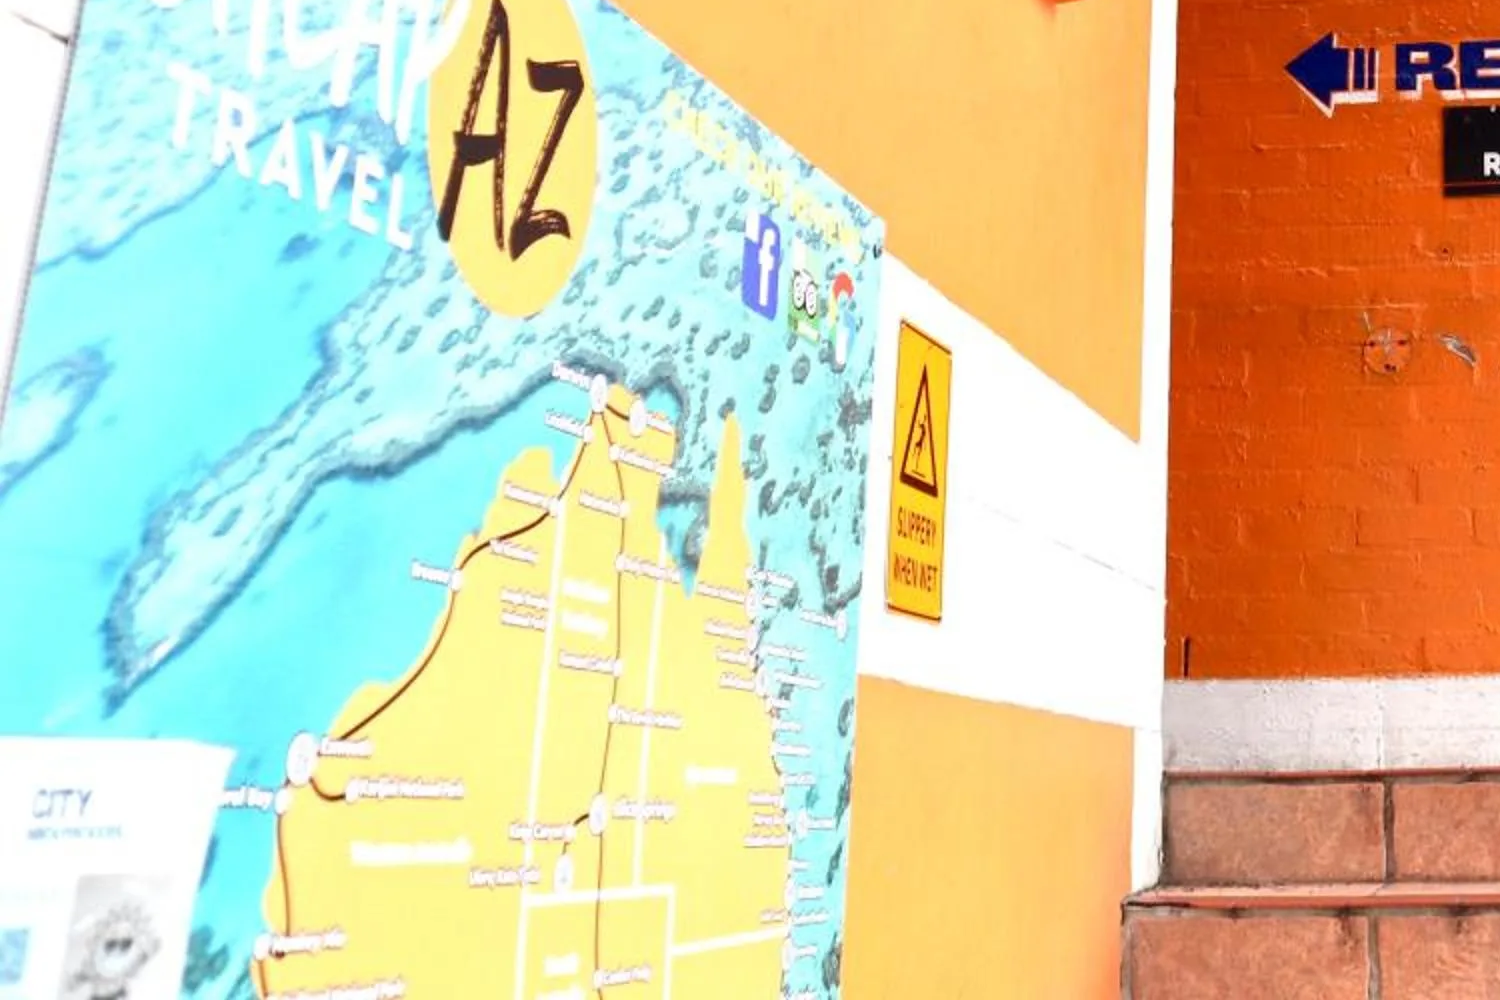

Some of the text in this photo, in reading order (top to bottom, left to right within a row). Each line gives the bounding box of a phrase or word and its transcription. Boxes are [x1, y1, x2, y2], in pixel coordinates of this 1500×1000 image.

[166, 61, 413, 252] TRAVEL
[896, 506, 937, 551] SLIPPERY
[893, 551, 938, 593] WHEN WET
